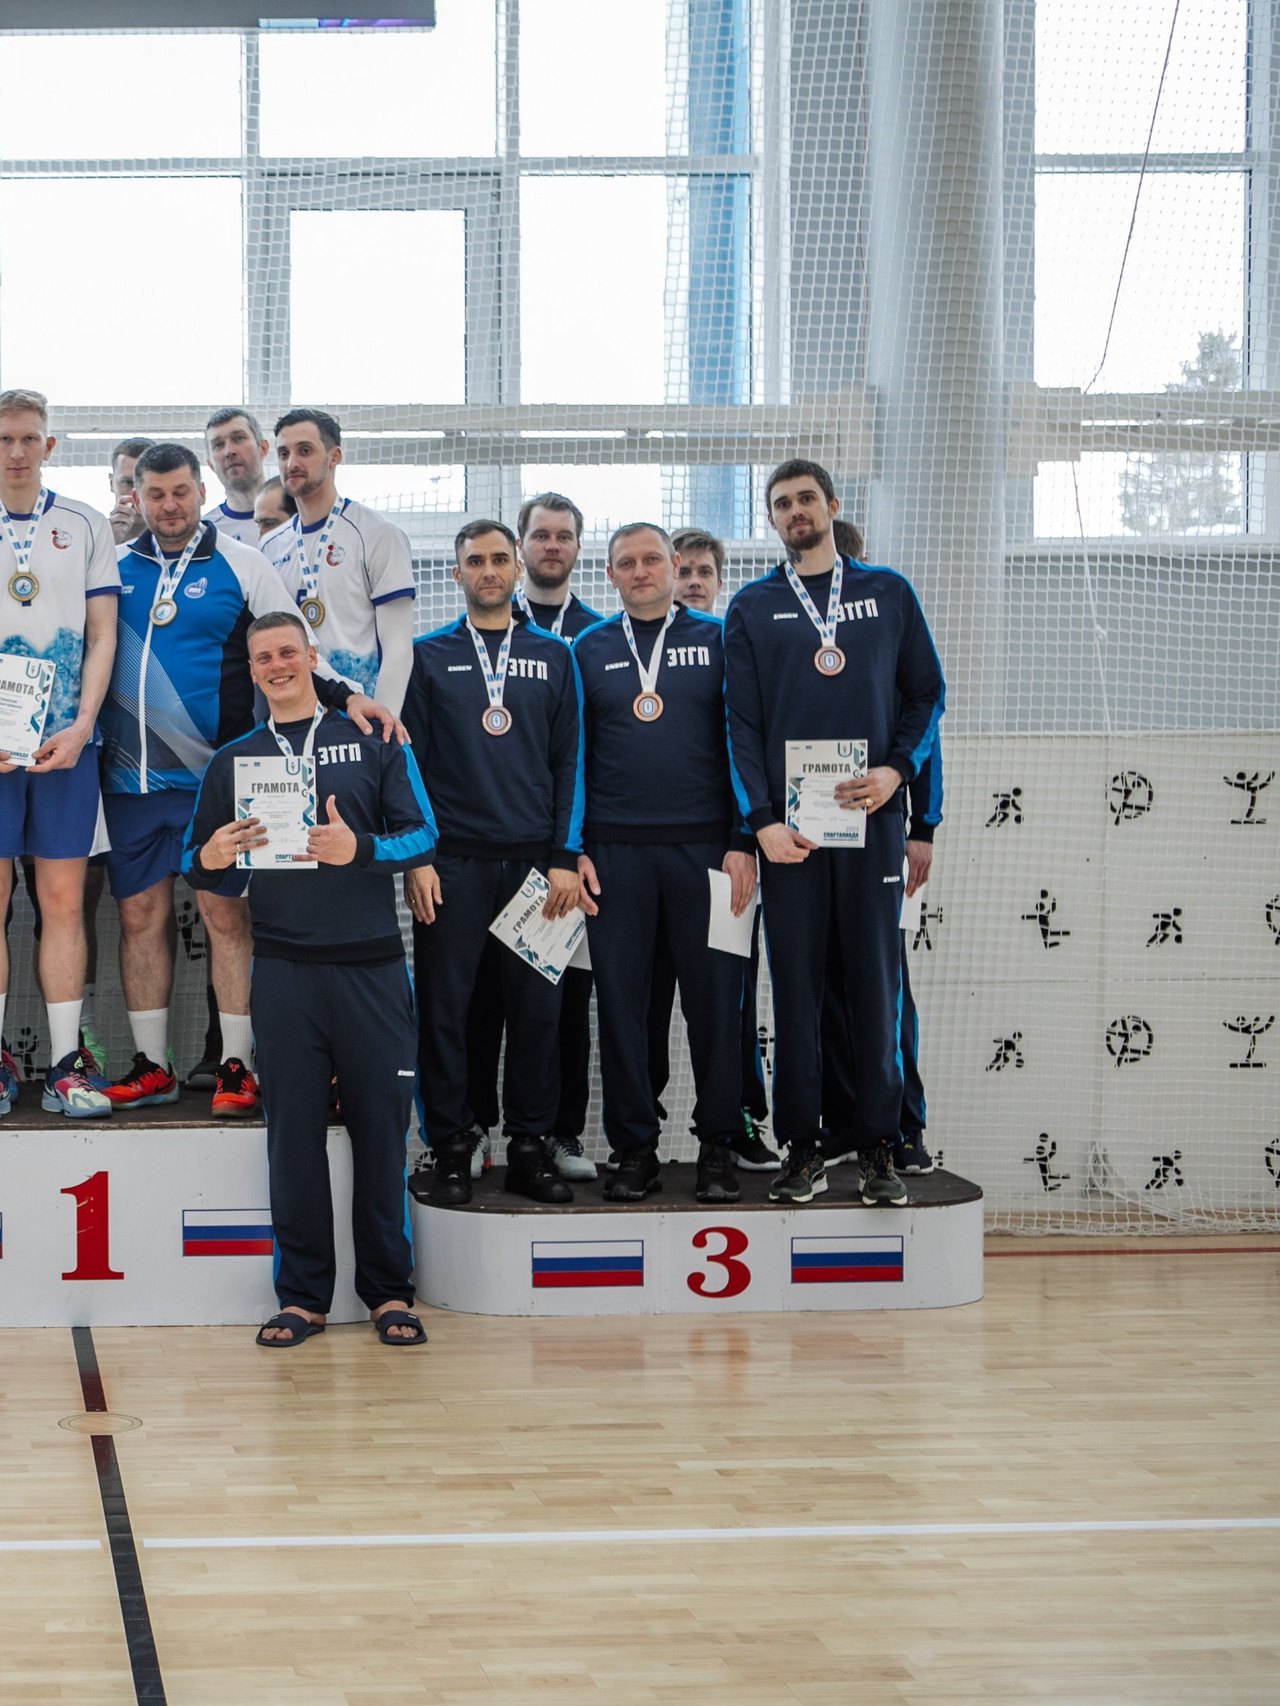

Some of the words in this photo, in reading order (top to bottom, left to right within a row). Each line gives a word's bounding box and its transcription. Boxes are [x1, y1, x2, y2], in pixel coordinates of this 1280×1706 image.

[666, 646, 710, 667] ЗТГП
[508, 658, 548, 680] ЗТГП
[318, 743, 361, 765] ЗТГП
[803, 763, 851, 774] ГРАМОТА
[251, 782, 299, 794] ГРАМОТА
[512, 895, 546, 934] ГРАМОТА
[60, 1170, 125, 1281] 1
[686, 1226, 751, 1298] 3
